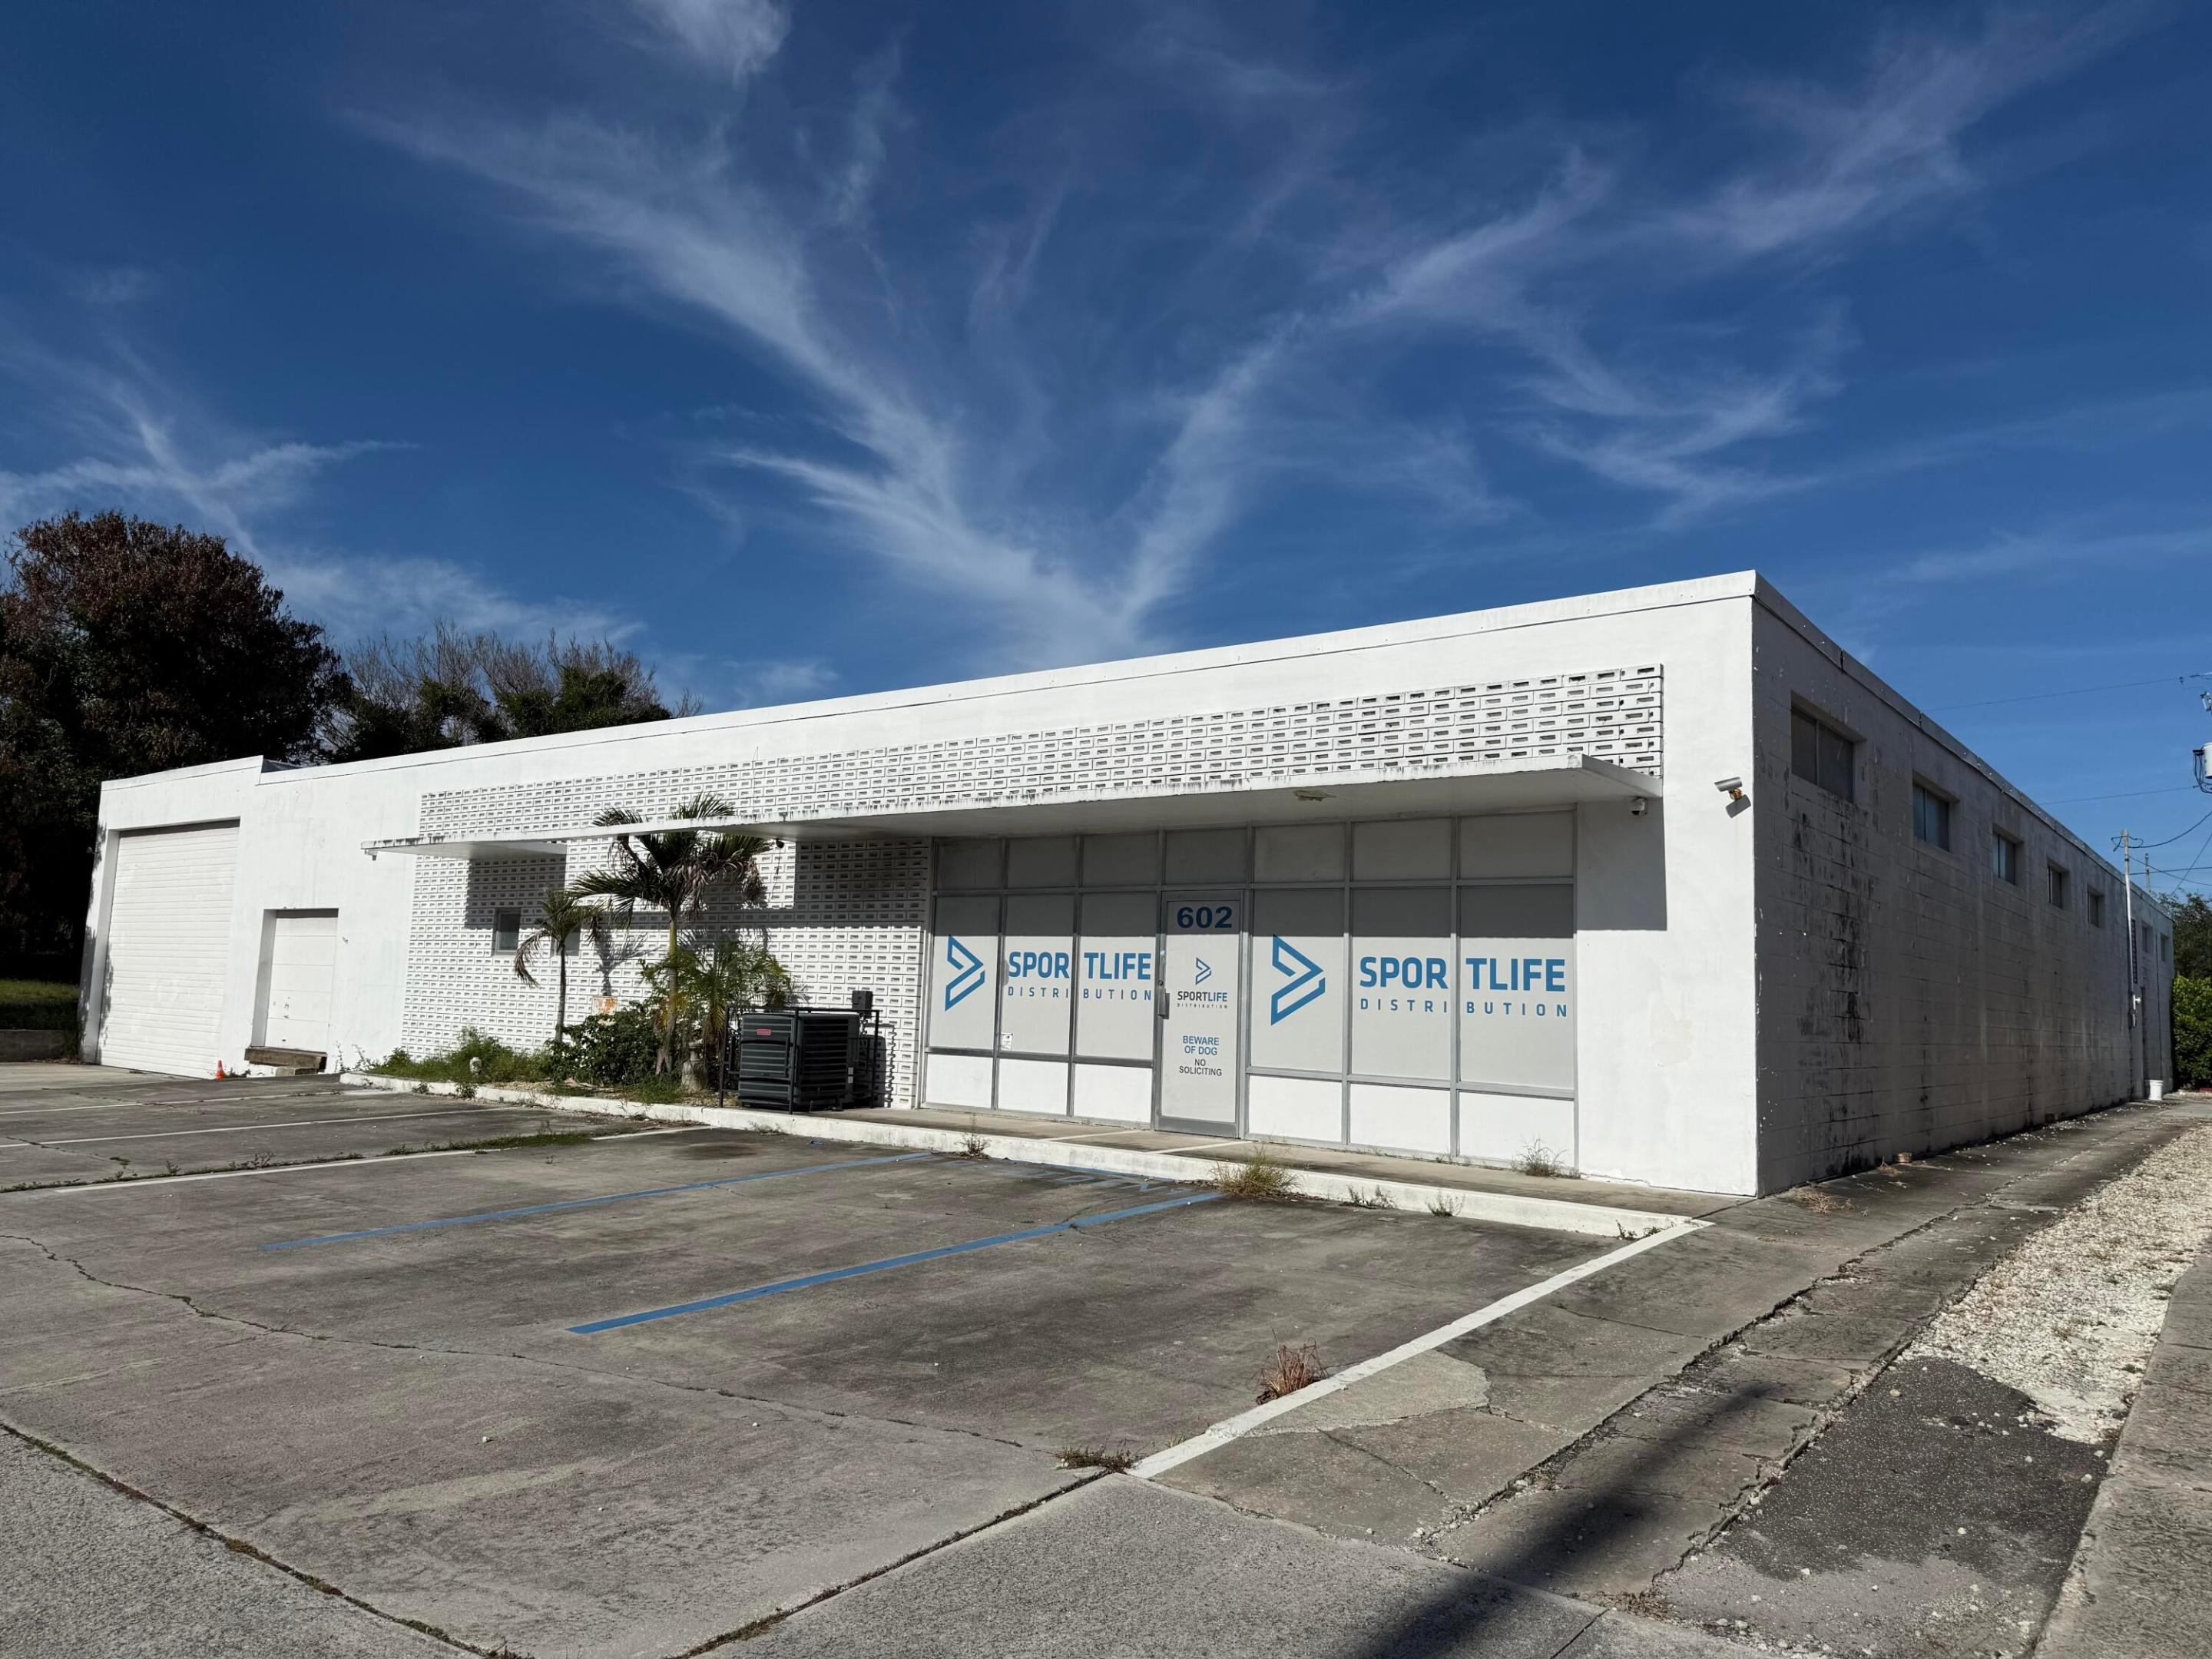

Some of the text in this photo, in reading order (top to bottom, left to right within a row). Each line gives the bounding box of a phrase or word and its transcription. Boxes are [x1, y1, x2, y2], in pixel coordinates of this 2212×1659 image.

[1177, 906, 1233, 929] 602
[1177, 991, 1227, 1002] SPORTLIFE
[1183, 1035, 1220, 1045] BEWARE
[1184, 1045, 1217, 1056] OF DOG
[1194, 1058, 1207, 1067] NO
[1179, 1066, 1223, 1077] SOLICITING
